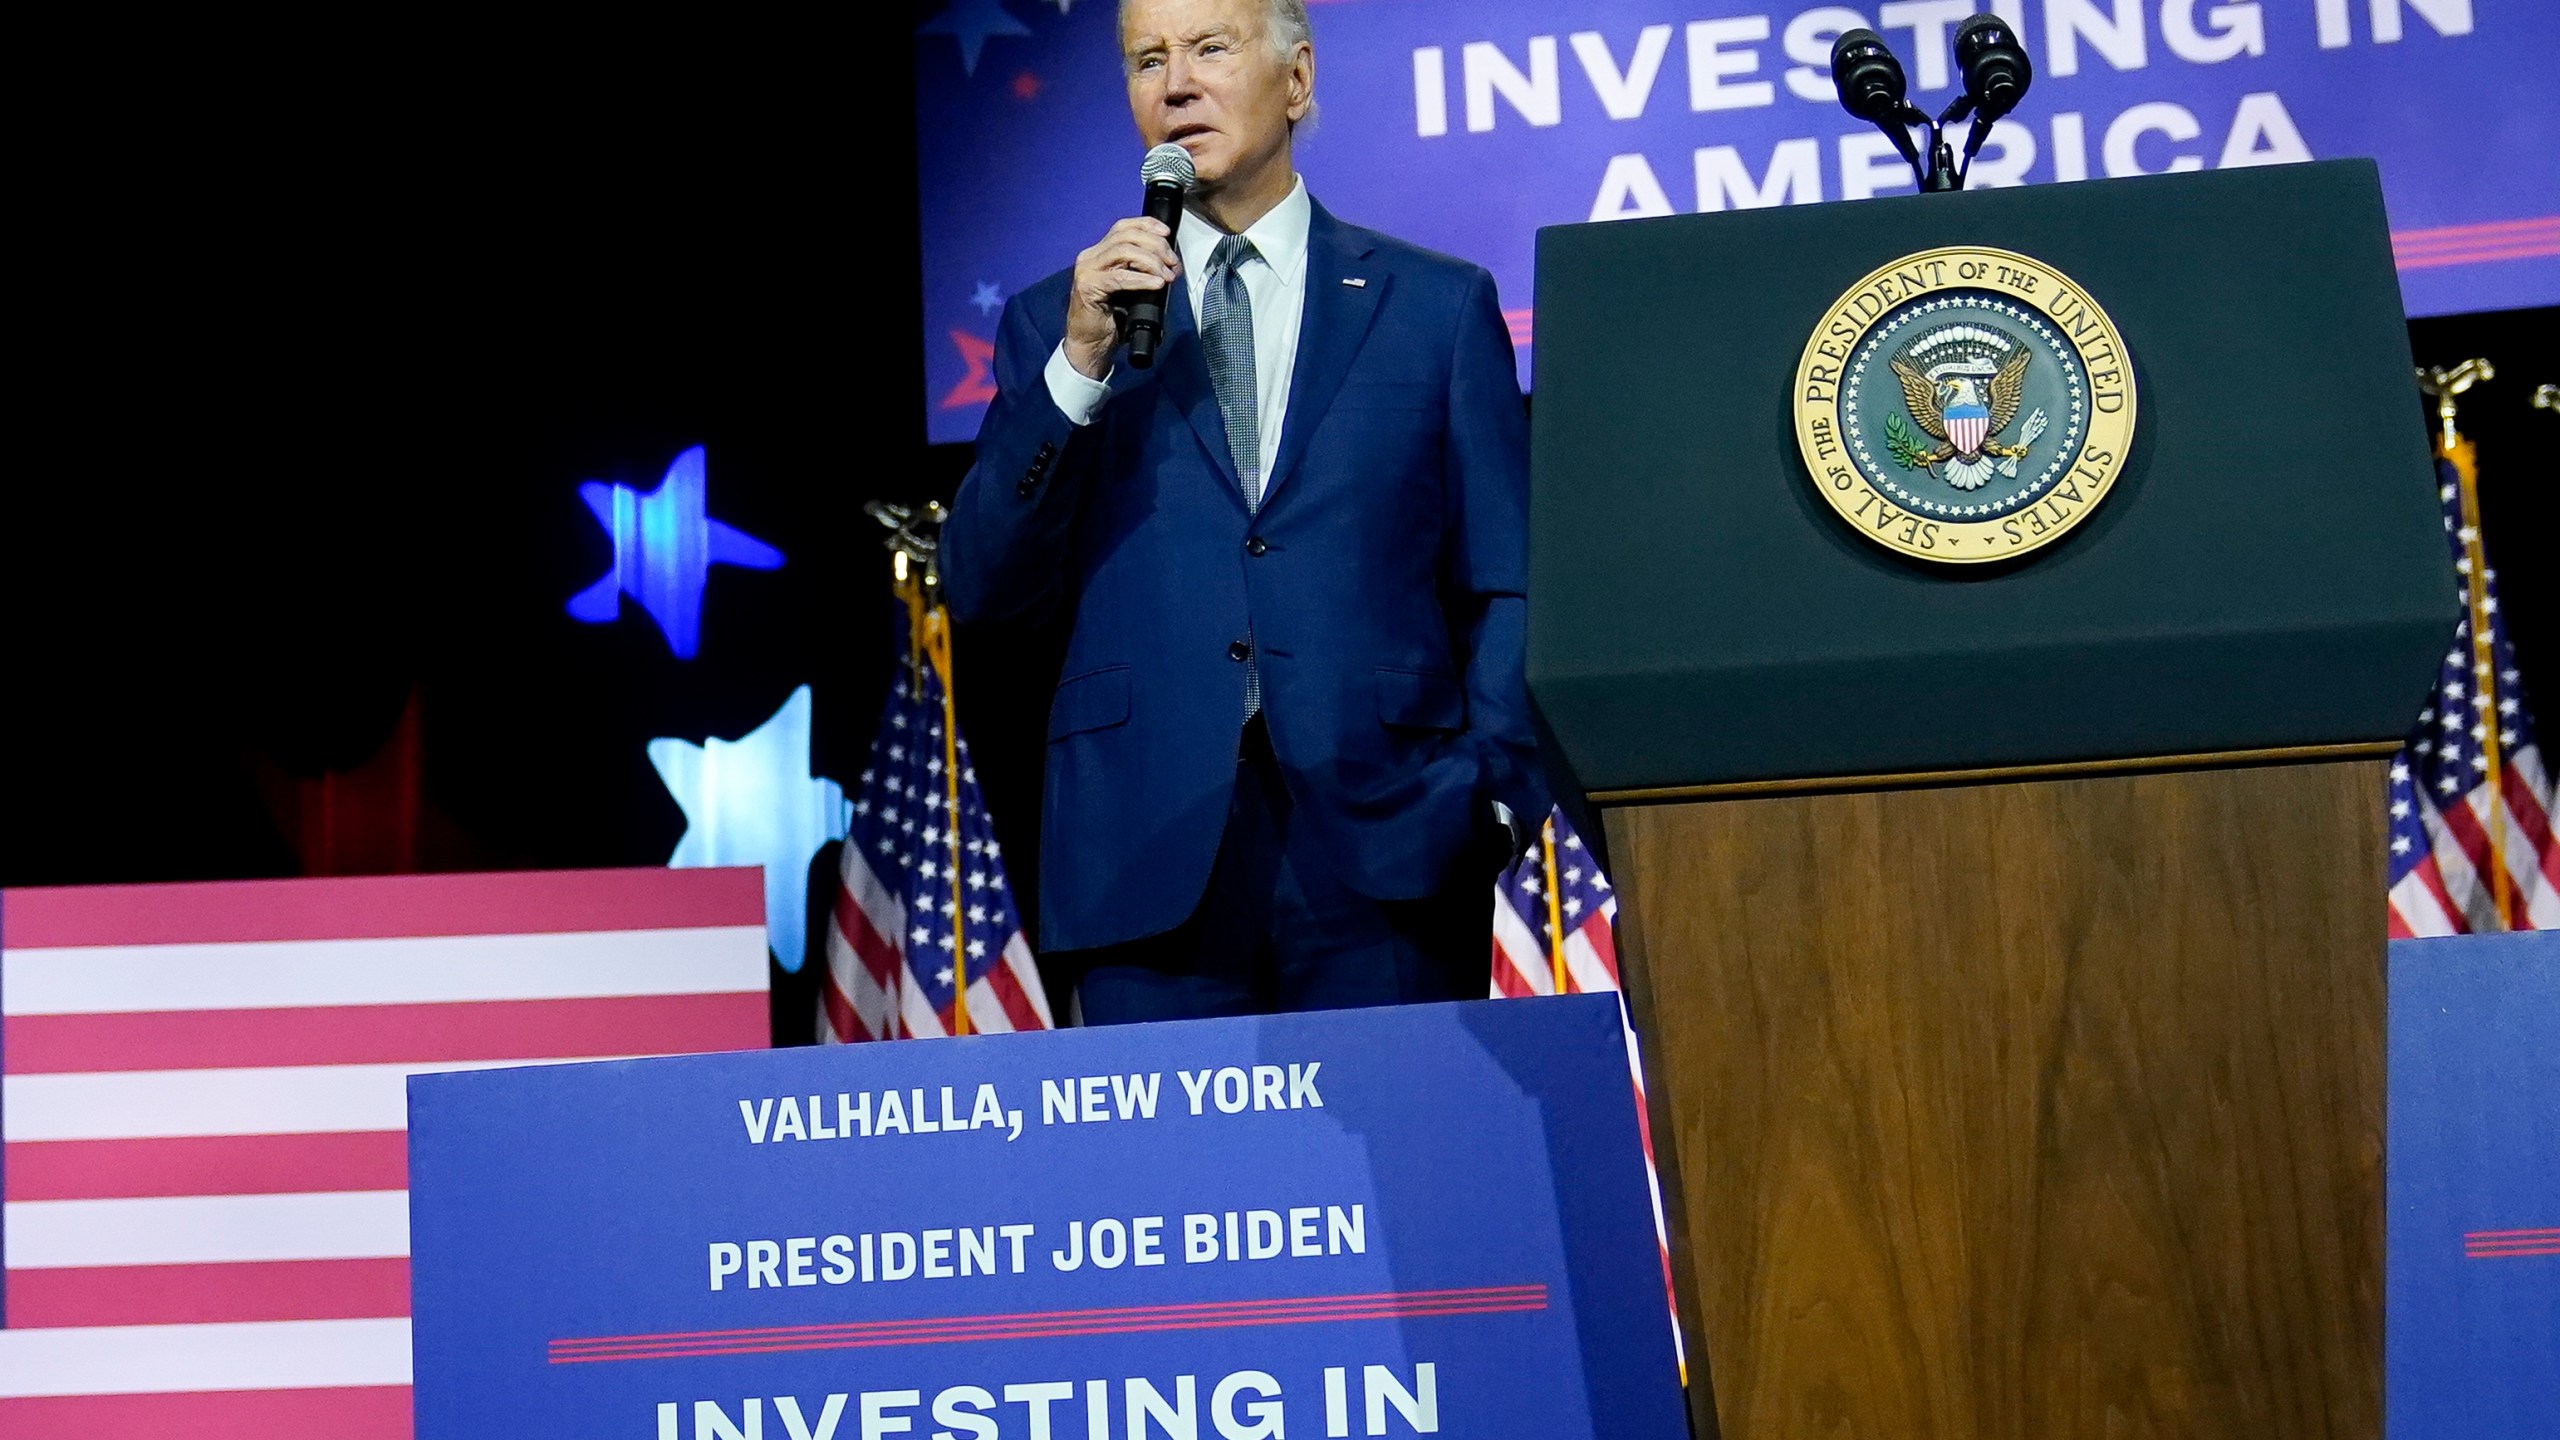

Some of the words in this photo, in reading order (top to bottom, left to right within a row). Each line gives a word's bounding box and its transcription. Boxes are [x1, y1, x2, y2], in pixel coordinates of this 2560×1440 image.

[1588, 93, 2314, 222] AMERICA
[1958, 262, 1989, 280] OF
[1997, 266, 2038, 294] THE
[1807, 260, 1947, 404] PRESIDENT
[2049, 288, 2123, 413] UNITED
[1812, 417, 1837, 460] THE
[1826, 465, 1853, 491] OF
[1854, 489, 1940, 549] SEAL
[2002, 445, 2113, 545] STATES
[739, 1083, 1023, 1144] VALHALLA,
[1042, 1072, 1160, 1125] NEW
[1177, 1062, 1324, 1116] YORK
[709, 1225, 1035, 1292] PRESIDENT
[1052, 1216, 1165, 1272] JOE
[1183, 1205, 1366, 1265] BIDEN
[656, 1370, 1287, 1440] INVESTING
[1324, 1362, 1440, 1438] IN
